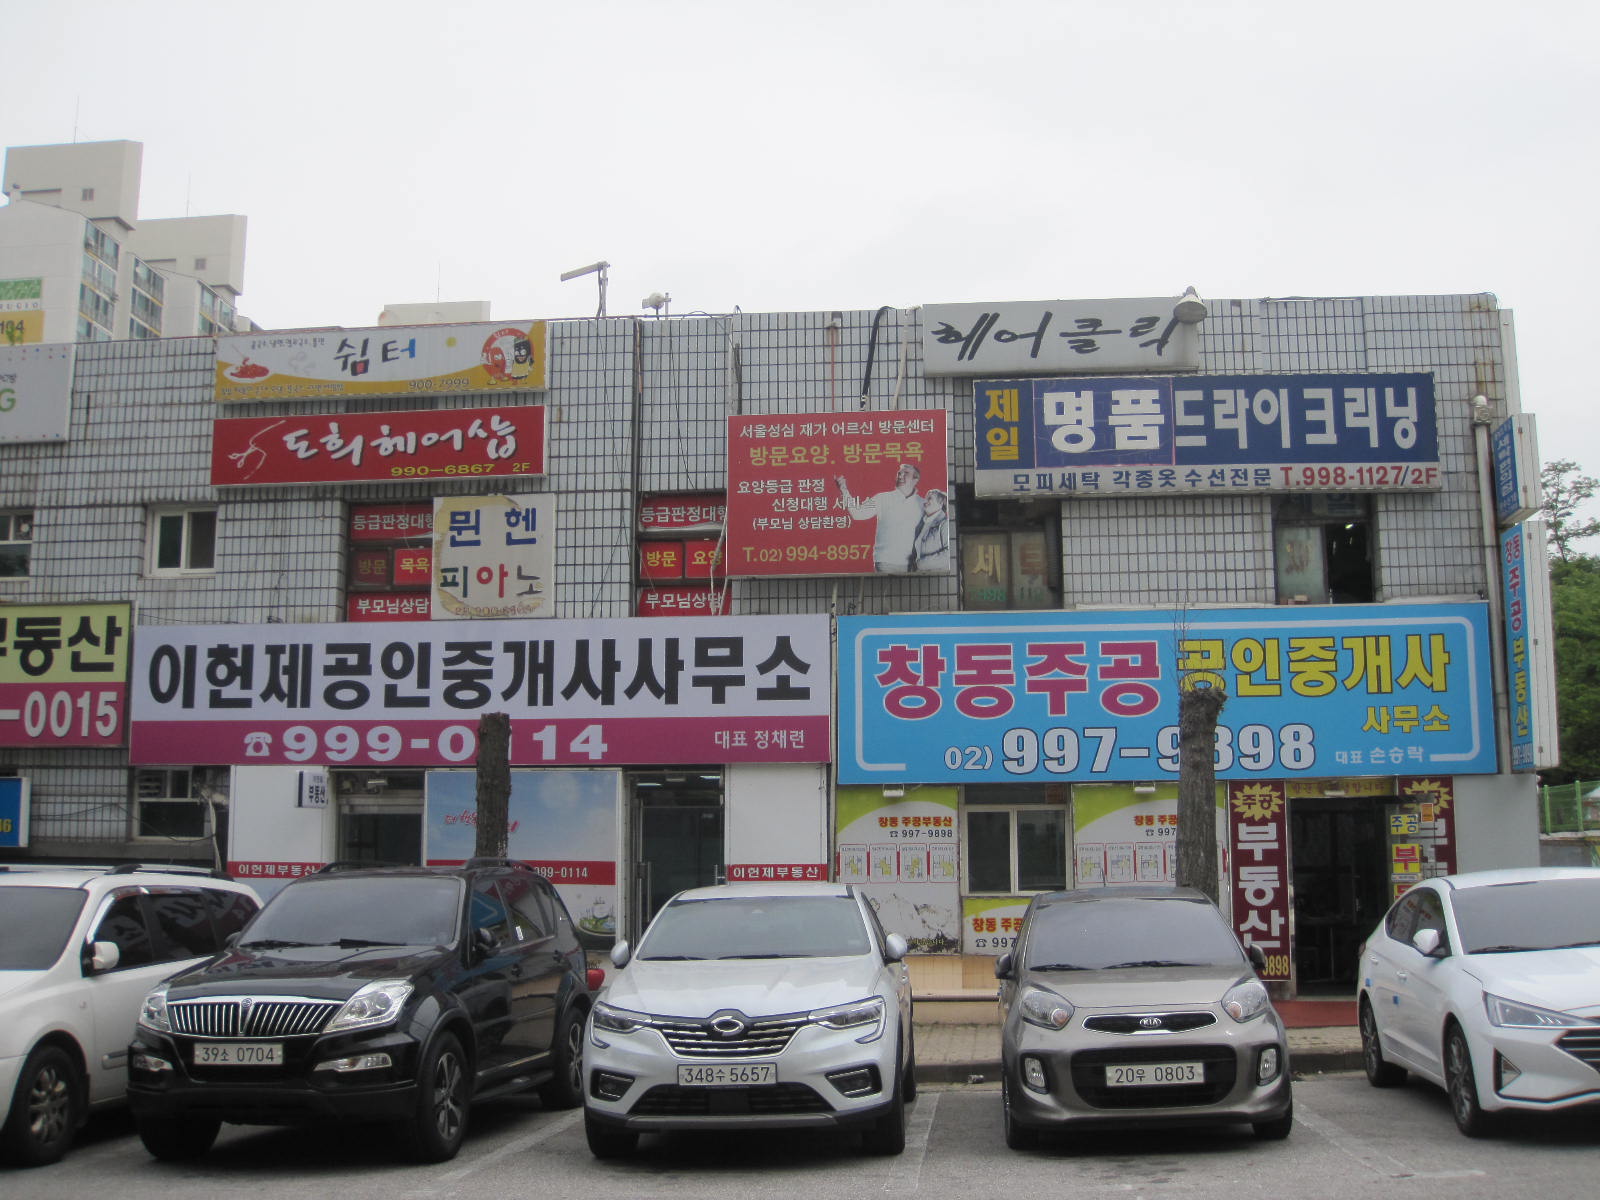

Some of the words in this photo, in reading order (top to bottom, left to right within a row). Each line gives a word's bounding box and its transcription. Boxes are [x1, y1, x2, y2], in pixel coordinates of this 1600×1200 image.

[334, 337, 416, 376] 쉼터
[740, 424, 795, 438] 서울성심
[799, 422, 827, 437] 재가
[832, 421, 873, 435] 어르신
[879, 419, 935, 434] 방문센터
[985, 389, 1020, 461] 제일
[282, 415, 516, 466] 도희헤어샵
[843, 442, 924, 464] 방문목욕
[391, 463, 495, 477] 990-6867
[512, 463, 530, 473] 2F
[737, 480, 793, 494] 요양등급
[798, 479, 825, 493] 판정
[1013, 473, 1100, 492] 모피세탁
[1113, 470, 1176, 488] 각종옷
[1184, 469, 1272, 487] 수선전문
[772, 498, 828, 512] 신청대행
[449, 508, 537, 548] 뮌헨
[752, 517, 793, 530] (부모님
[798, 515, 852, 529] 상담환영)
[646, 551, 676, 567] 방문
[787, 545, 871, 561] 994-8957
[400, 558, 430, 574] 목욕
[440, 563, 543, 599] 피아노
[356, 598, 429, 614] 부모님상담
[0, 616, 122, 676] 동산
[149, 635, 811, 710] 이헌제공인중개사사무소
[874, 641, 1161, 720] 창동주공
[1177, 633, 1450, 697] 공인중개사
[1362, 705, 1450, 734] 사무소
[282, 724, 608, 762] 999-014
[714, 730, 748, 749] 대표
[754, 730, 805, 749] 정채련
[1335, 751, 1363, 764] 대표
[1242, 794, 1273, 810] 주공
[901, 829, 953, 838] 997-9898
[733, 866, 819, 879] 이헌제부동산
[1236, 822, 1285, 949] 부동산
[1142, 1017, 1159, 1026] KIA
[202, 1047, 229, 1062] 39소
[236, 1047, 275, 1062] 0704
[684, 1068, 726, 1083] 348수
[730, 1066, 770, 1082] 5657
[1115, 1068, 1146, 1083] 20우
[1154, 1066, 1195, 1081] 0803
